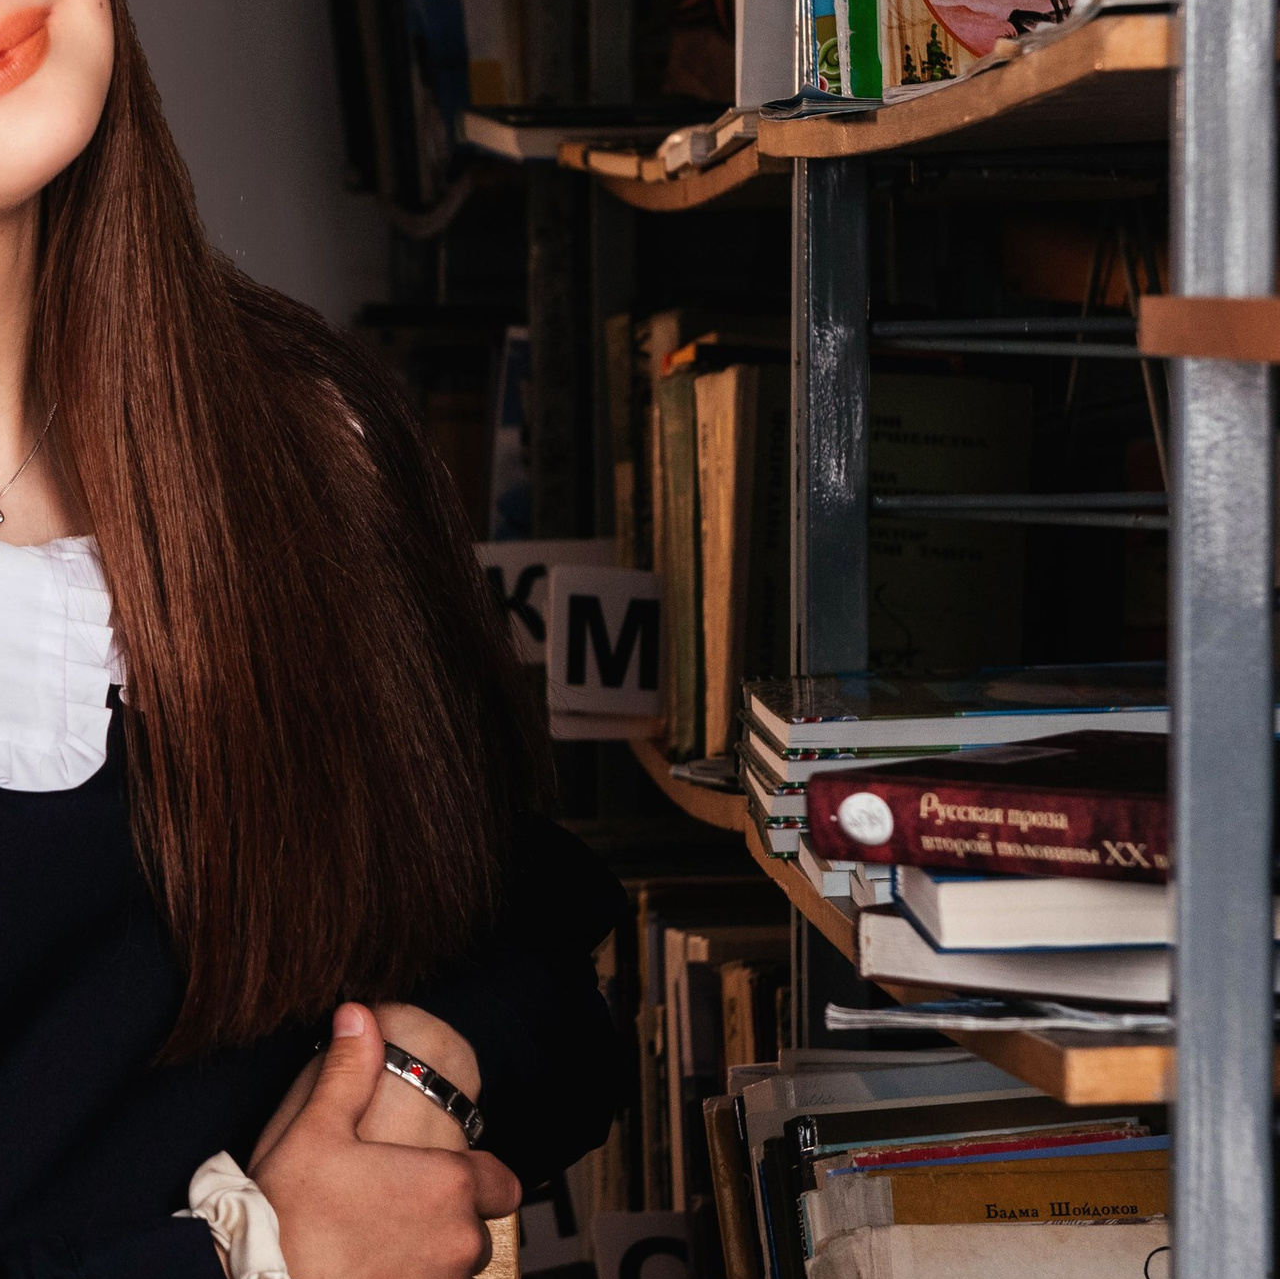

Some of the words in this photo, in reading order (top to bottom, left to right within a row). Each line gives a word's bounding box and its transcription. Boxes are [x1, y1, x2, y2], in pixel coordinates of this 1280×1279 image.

[567, 594, 661, 690] М
[920, 792, 1003, 826] Русская
[1007, 808, 1068, 832] проза
[921, 832, 993, 858] второй
[996, 843, 1100, 865] половины
[986, 1203, 1039, 1219] Бадма
[1050, 1200, 1139, 1218] Шойдоков
